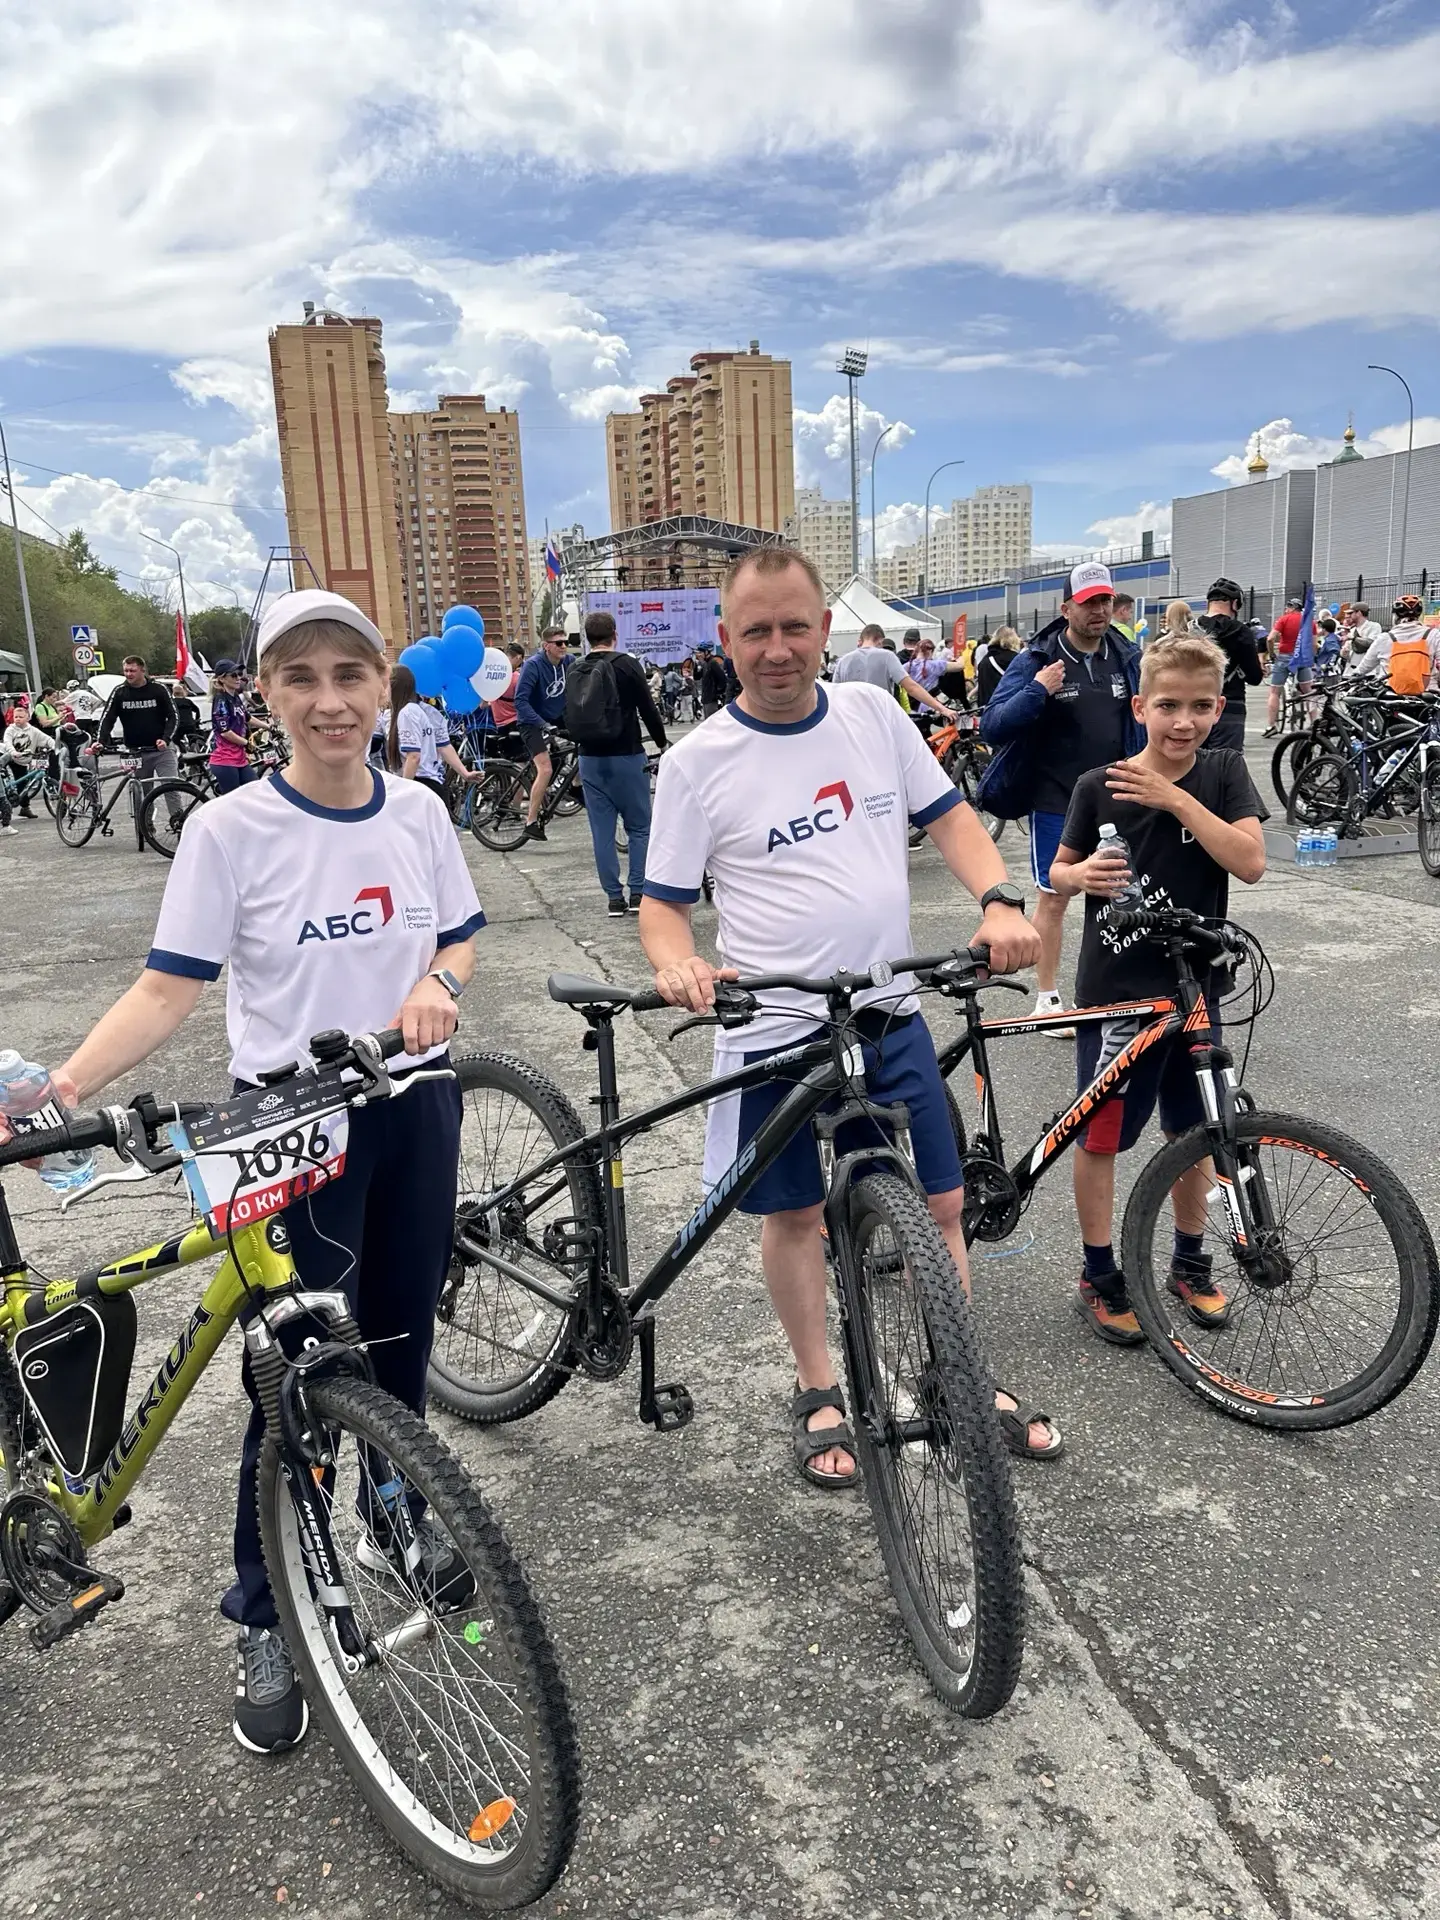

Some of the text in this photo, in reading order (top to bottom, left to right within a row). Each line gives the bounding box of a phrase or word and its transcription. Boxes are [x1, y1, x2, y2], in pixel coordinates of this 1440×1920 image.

[77, 650, 91, 660] 20
[485, 672, 507, 681] ЛДПР
[122, 699, 157, 709] FEARLESS
[866, 799, 894, 811] Большой
[868, 808, 892, 819] Страны
[768, 809, 839, 853] АБС
[297, 911, 374, 945] АБС
[1001, 1025, 1037, 1035] HW-701
[764, 1049, 804, 1071] DIVIDE
[229, 1121, 329, 1188] 1096
[671, 1141, 757, 1259] JAMIS
[44, 1289, 77, 1306] LAHA
[94, 1304, 213, 1506] MERIDA
[303, 1500, 335, 1586] MERIDA
